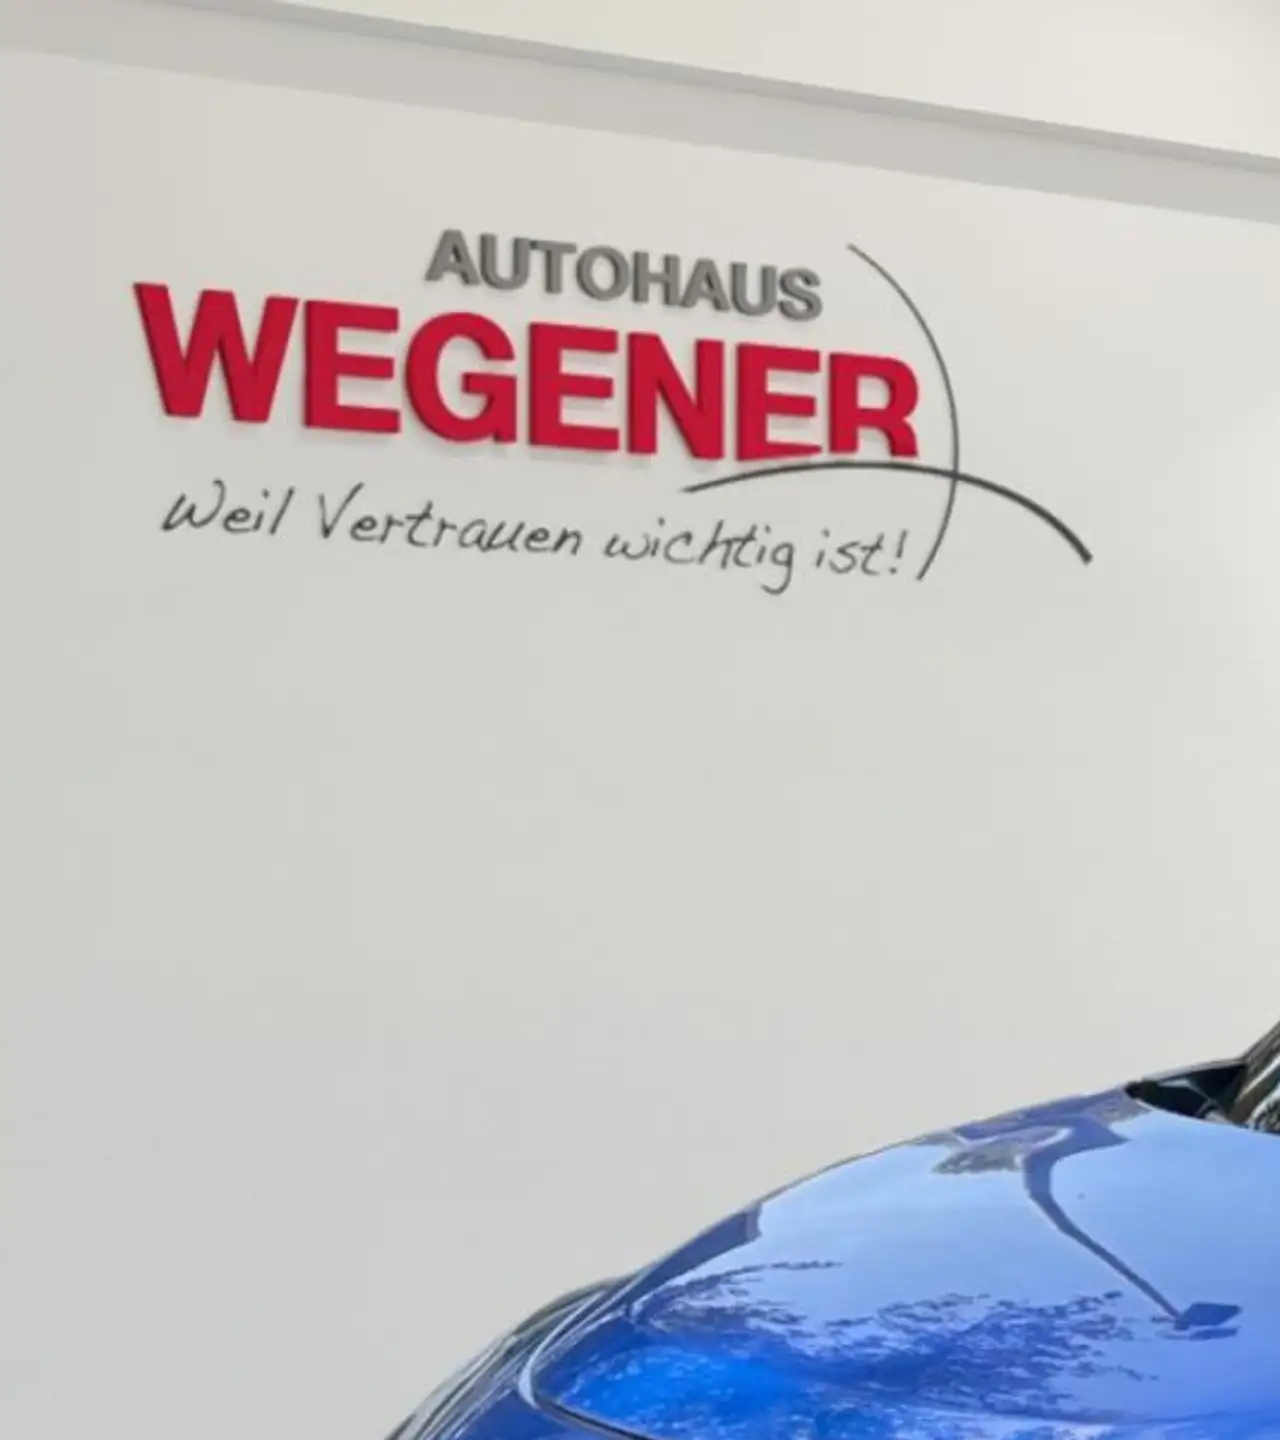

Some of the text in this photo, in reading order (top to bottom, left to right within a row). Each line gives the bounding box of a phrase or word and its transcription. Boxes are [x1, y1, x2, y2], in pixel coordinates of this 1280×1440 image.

[425, 229, 822, 321] AUTOHAUS
[134, 282, 921, 462] WEGENER
[162, 479, 908, 595] Weil Vertrauen wichtig ist!
